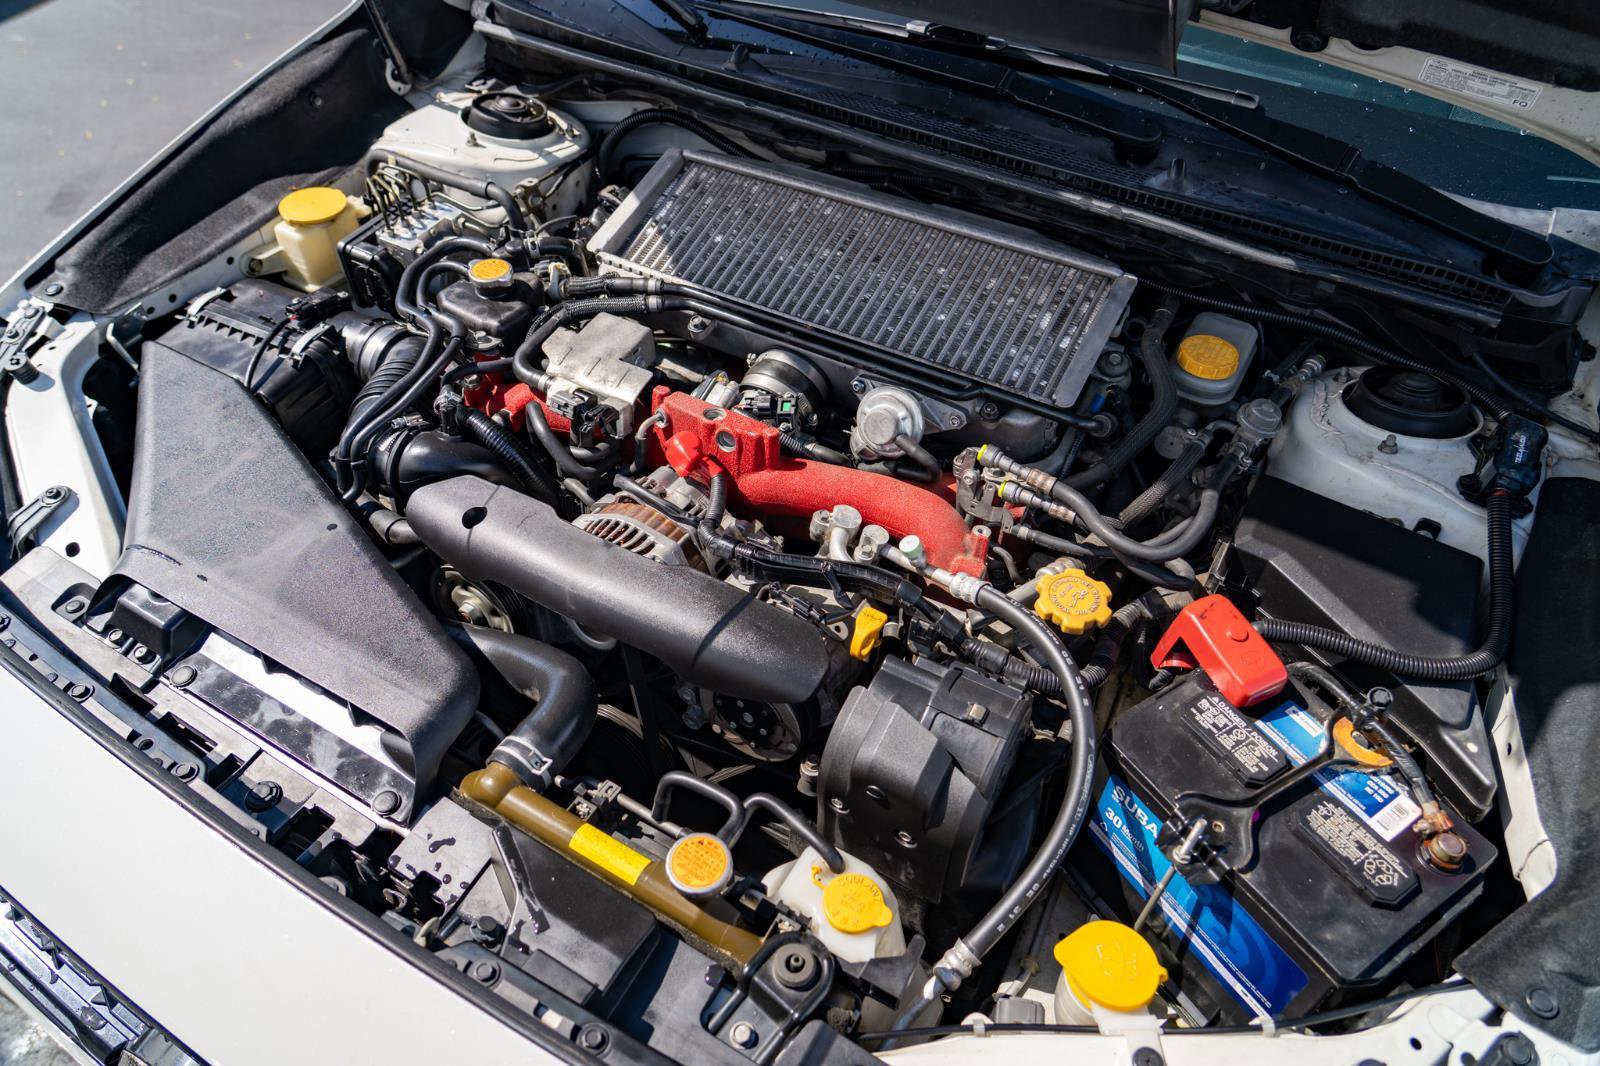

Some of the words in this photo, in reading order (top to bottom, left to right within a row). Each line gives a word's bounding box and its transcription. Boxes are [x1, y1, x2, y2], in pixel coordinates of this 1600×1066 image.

[1218, 701, 1246, 727] DANGER
[1252, 732, 1277, 756] POISON
[1105, 807, 1123, 828] 30
[1113, 785, 1158, 838] SUBA
